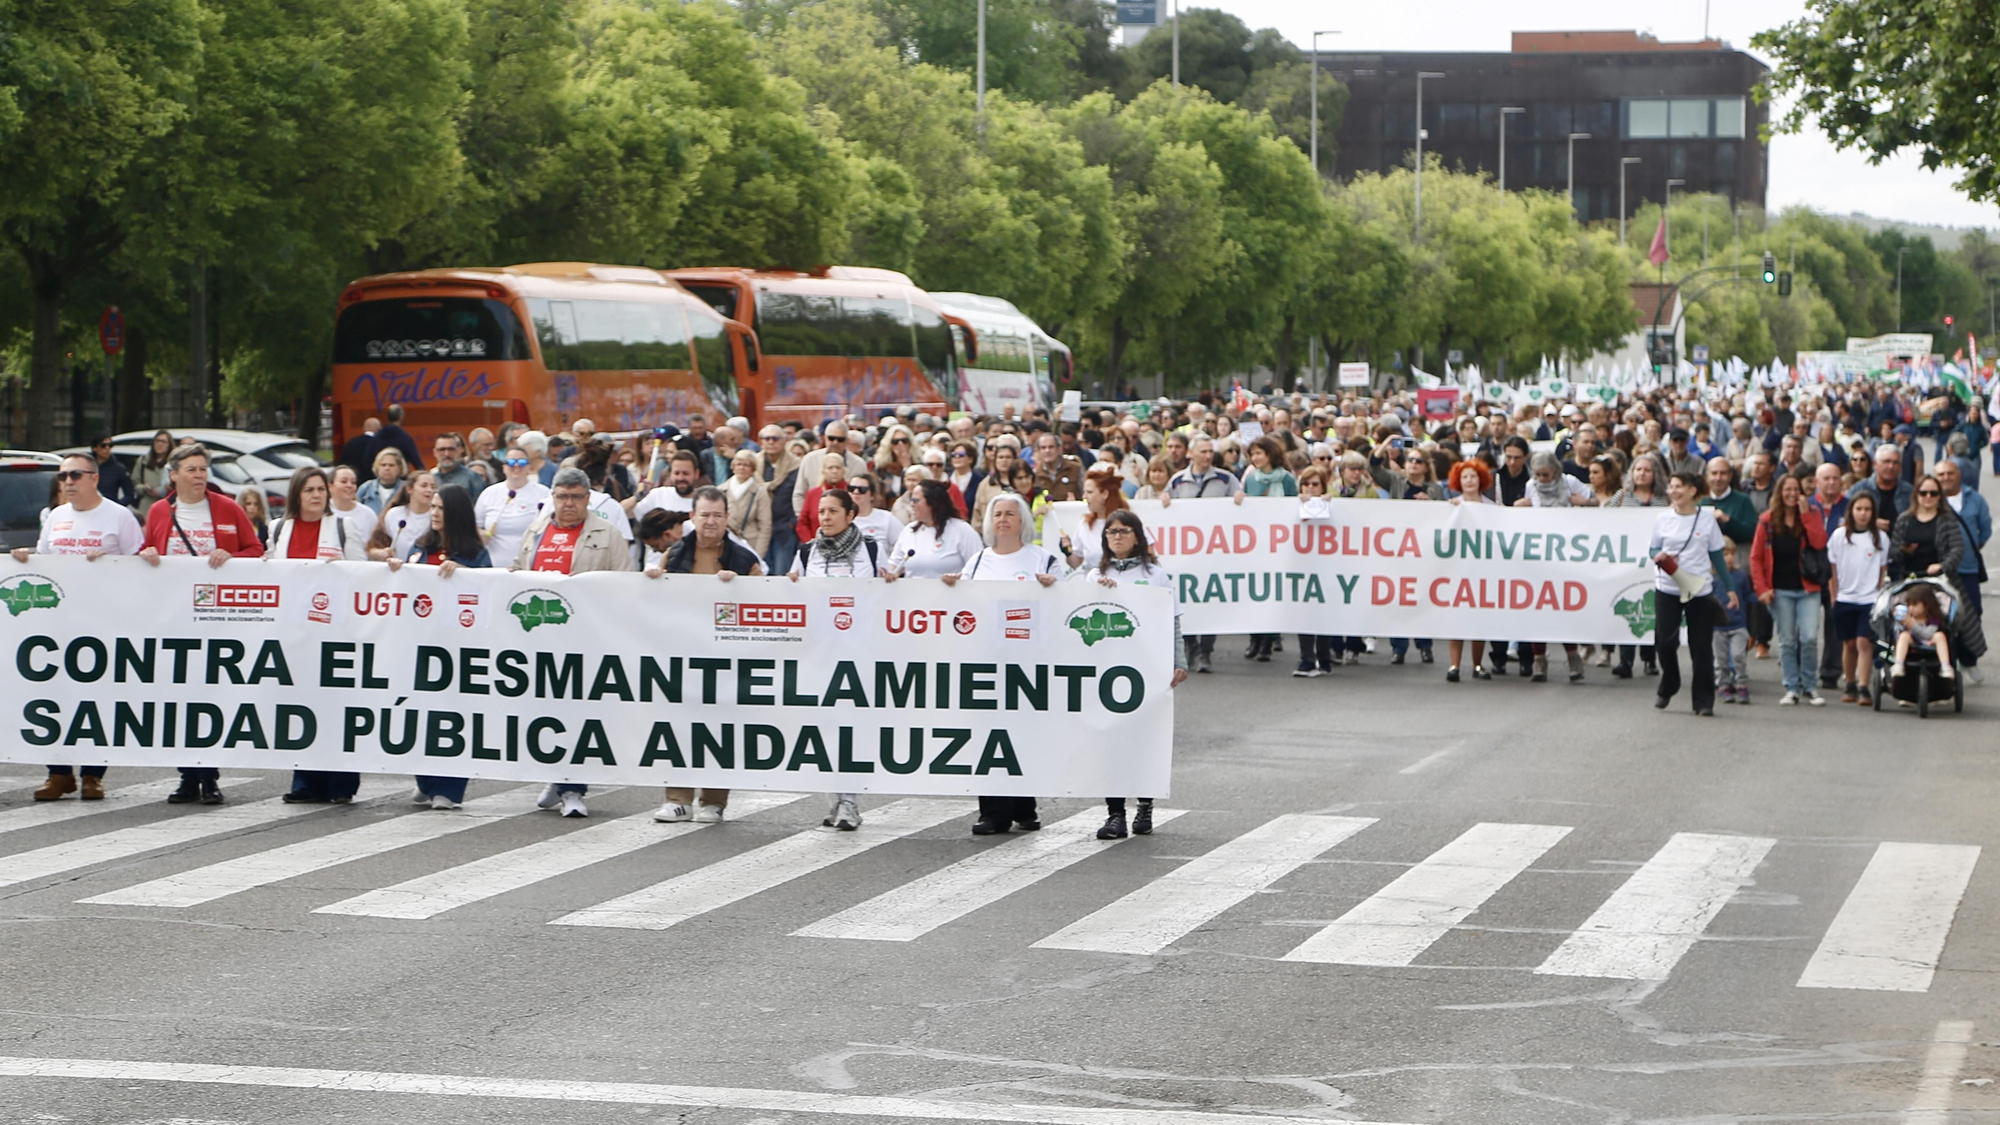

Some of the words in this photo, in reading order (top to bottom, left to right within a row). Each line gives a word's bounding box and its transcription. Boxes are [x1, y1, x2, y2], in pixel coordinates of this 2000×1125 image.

[353, 367, 503, 412] Valdés
[1434, 529, 1647, 568] UNIVERSAL,
[219, 587, 277, 605] CCOO
[354, 592, 408, 616] UGT
[1166, 573, 1325, 603] RATUITA
[1337, 574, 1360, 604] Y
[1372, 576, 1417, 607] DE
[1429, 577, 1588, 612] CALIDAD
[741, 606, 803, 624] CCOO
[886, 609, 948, 634] UGT
[17, 636, 294, 686] CONTRA
[320, 642, 390, 690] EL
[414, 646, 1145, 714] DESMANTELAMIENTO
[20, 699, 318, 751] SANIDAD
[343, 697, 618, 766] PÚBLICA
[638, 721, 1023, 776] ANDALUZA
